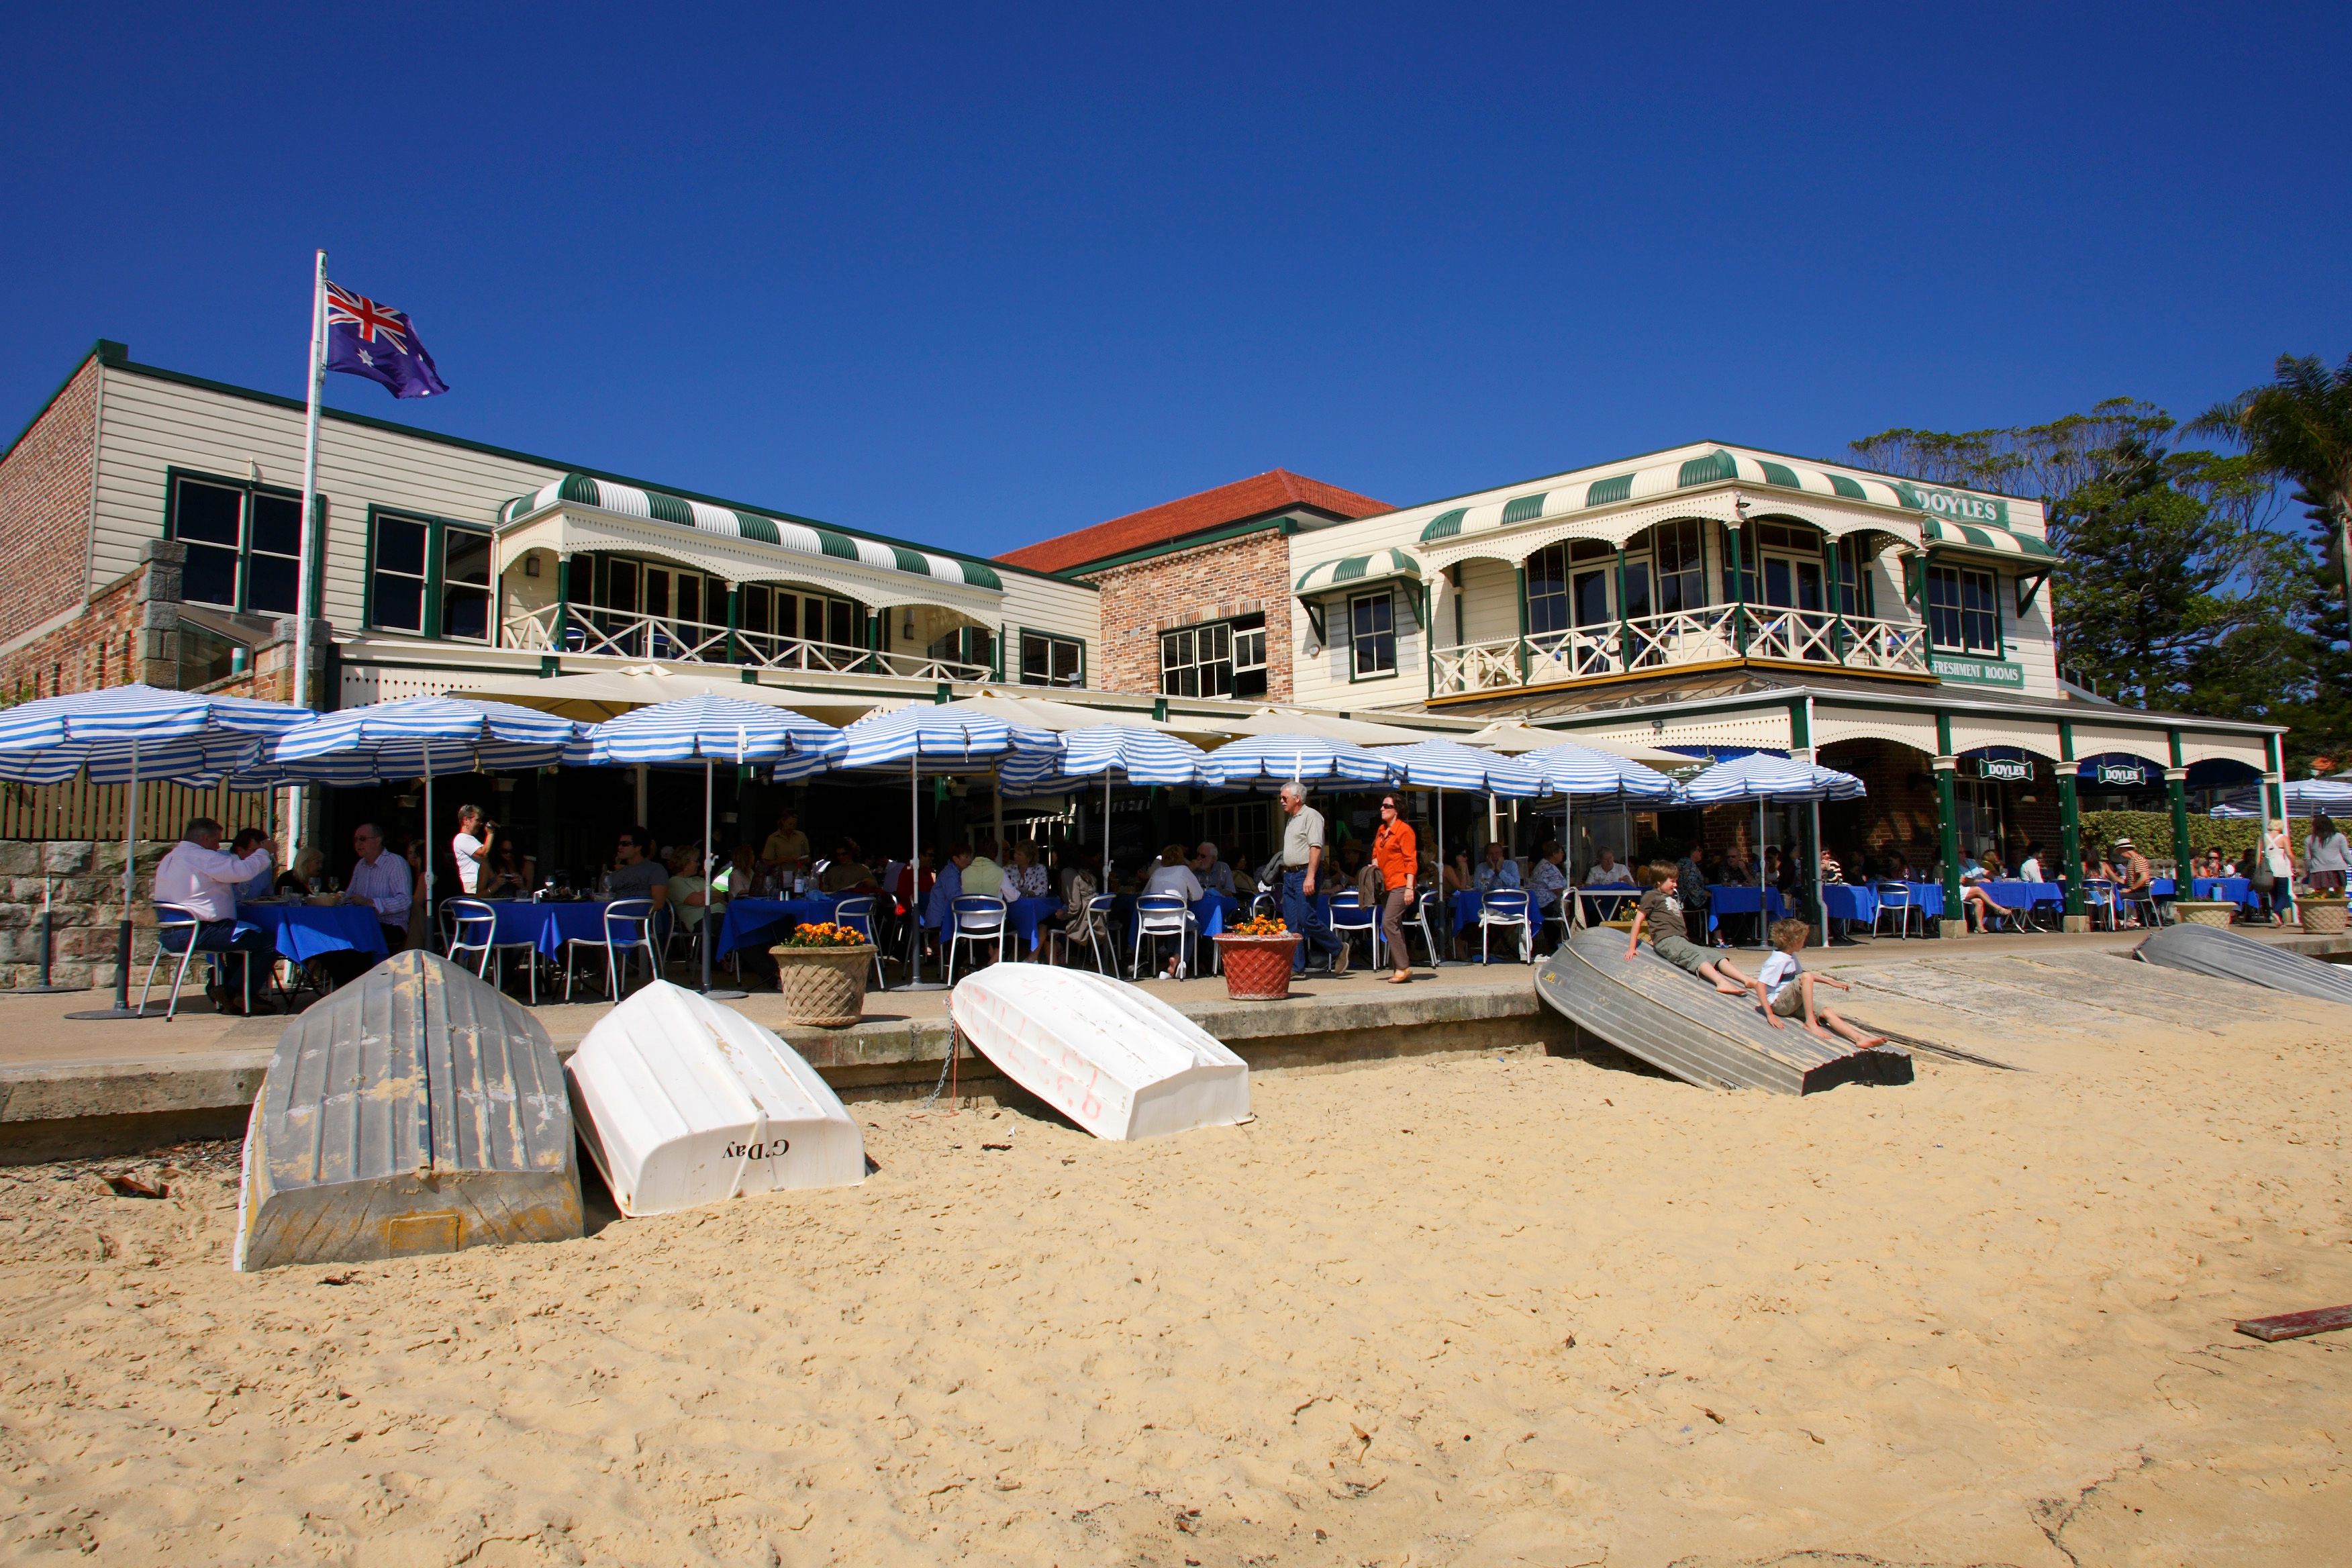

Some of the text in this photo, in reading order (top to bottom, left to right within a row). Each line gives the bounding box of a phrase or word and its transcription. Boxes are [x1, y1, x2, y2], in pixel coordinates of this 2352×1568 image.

[1914, 490, 1998, 521] DOYLES
[1922, 659, 2019, 681] FRESHMENT ROOMS
[1989, 764, 2026, 775] DOYLES
[2105, 769, 2139, 780] DOYLES
[722, 1139, 789, 1160] G'Day
